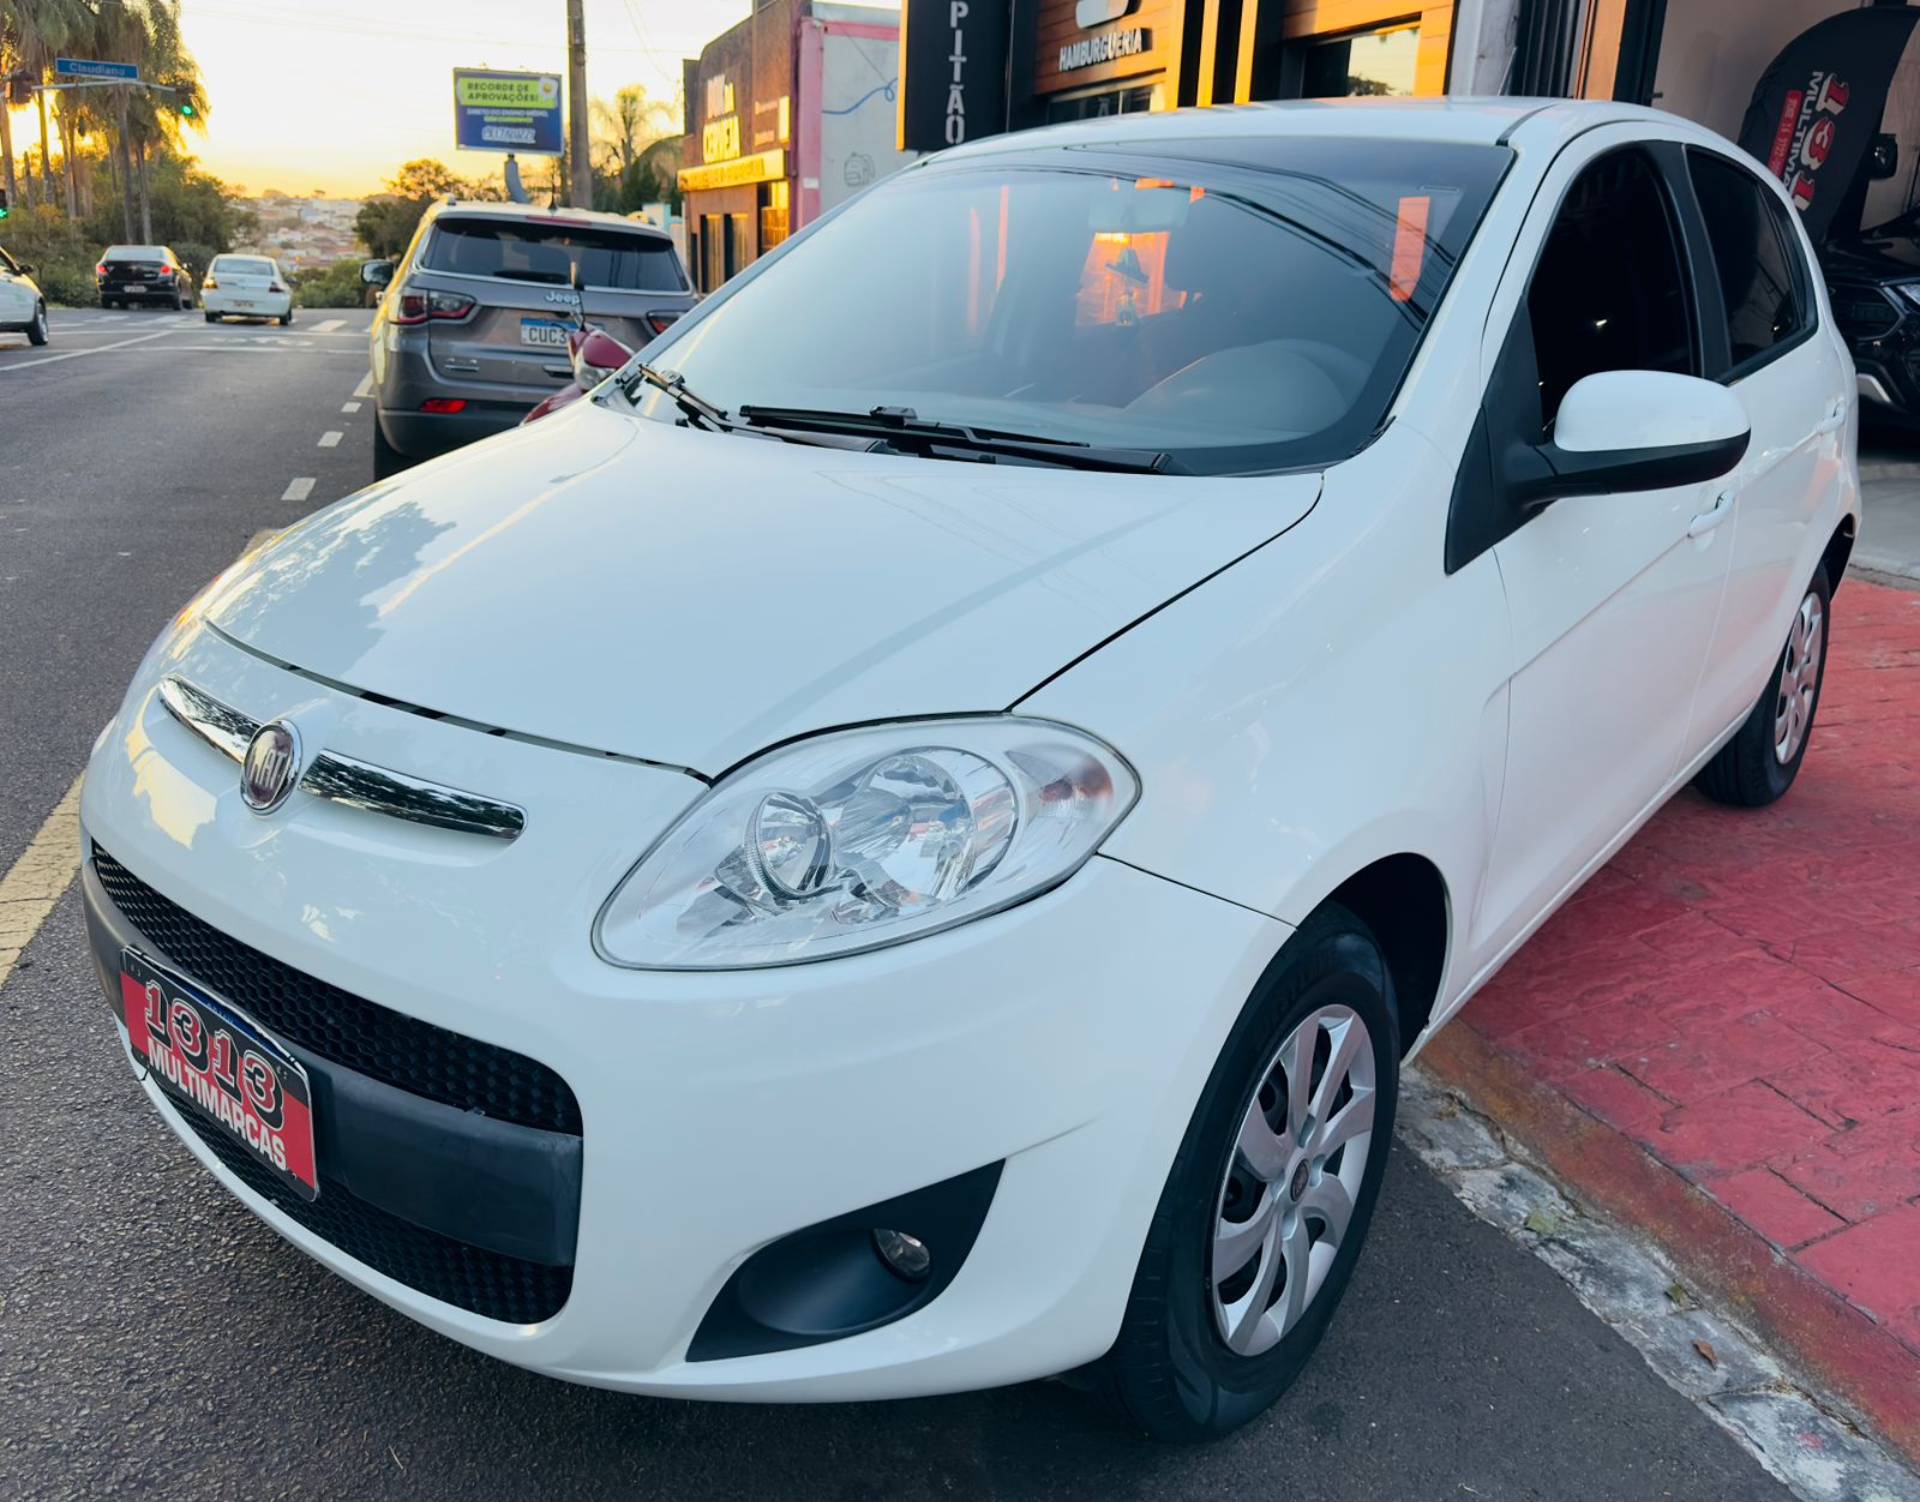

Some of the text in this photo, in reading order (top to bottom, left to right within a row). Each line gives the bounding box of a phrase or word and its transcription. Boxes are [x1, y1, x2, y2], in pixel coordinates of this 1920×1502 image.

[1059, 28, 1142, 71] HAMBURGUERIA
[69, 63, 126, 75] Claudiano
[467, 82, 529, 92] RECORDE DE
[544, 291, 581, 306] Jeep
[528, 326, 568, 345] CUC3
[144, 979, 286, 1132] 1313
[146, 1037, 288, 1171] MULTIMARCAS
